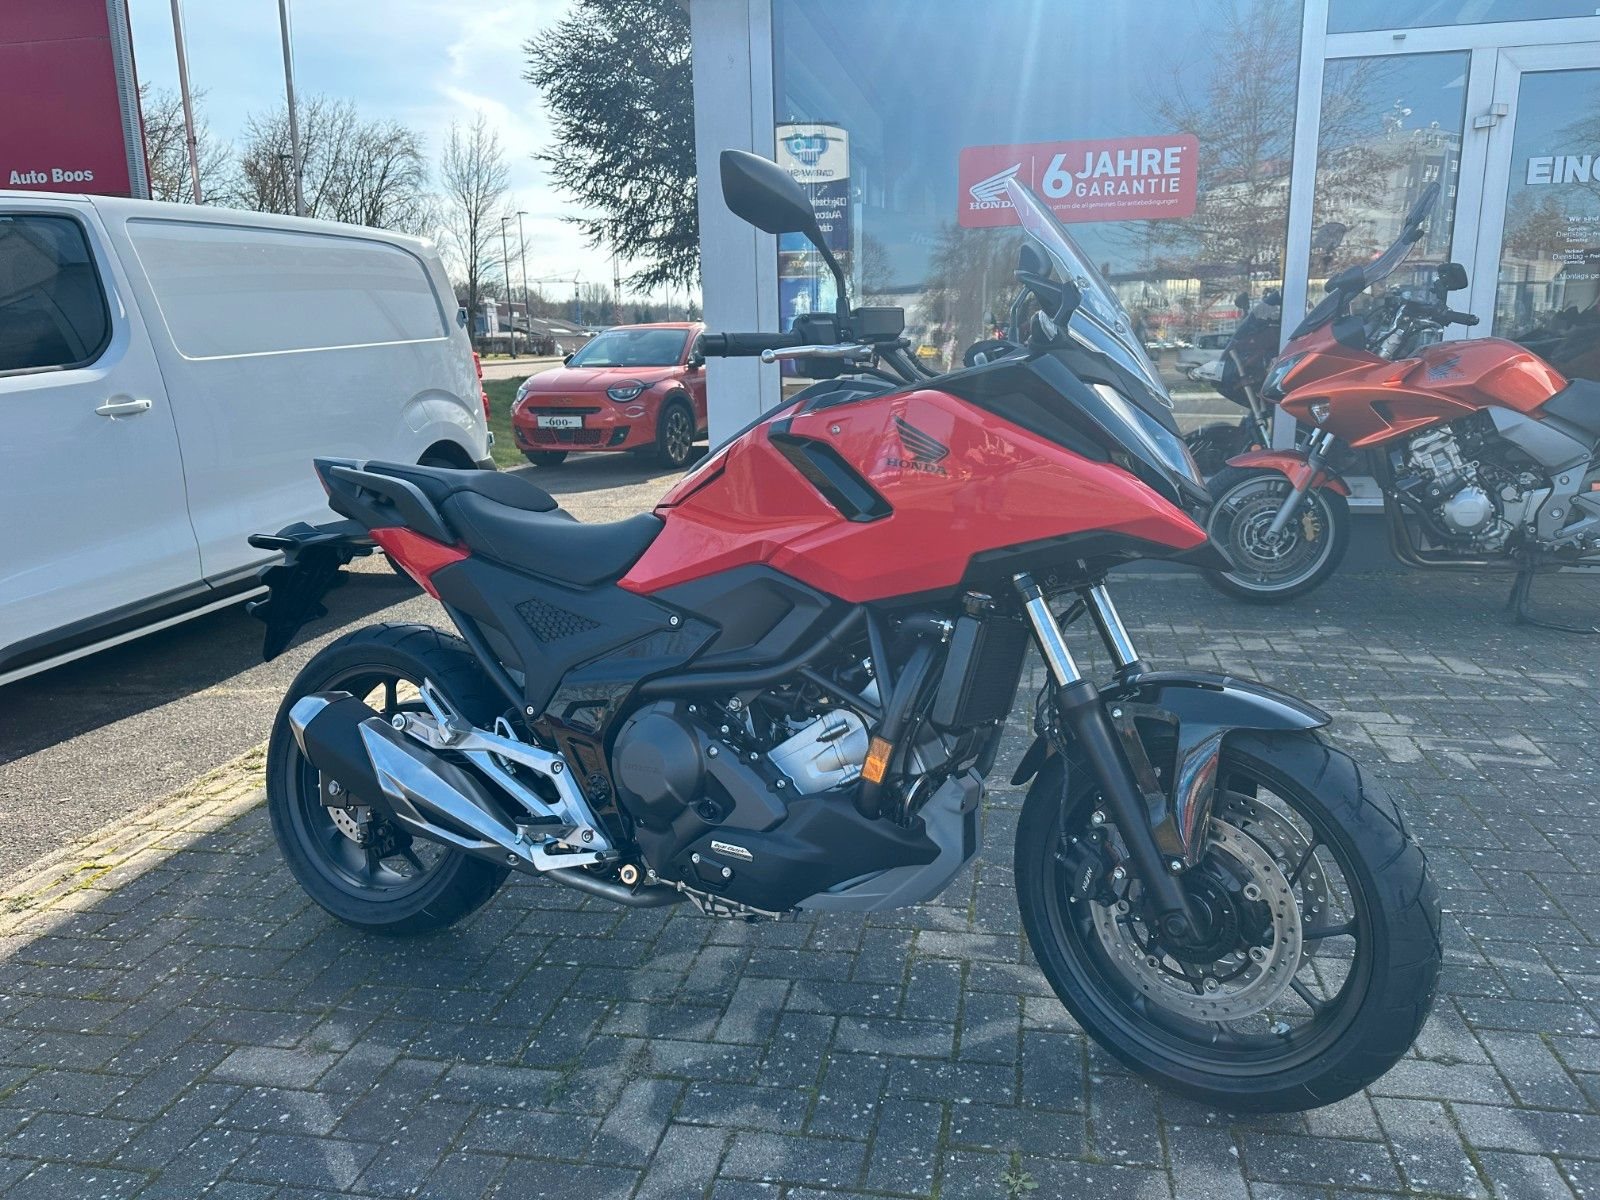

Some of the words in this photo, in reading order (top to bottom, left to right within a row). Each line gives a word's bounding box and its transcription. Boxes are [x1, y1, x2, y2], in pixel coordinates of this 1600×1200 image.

[9, 170, 48, 185] Auto
[52, 168, 94, 183] Boos
[1042, 153, 1073, 199] 6
[1075, 146, 1182, 179] JAHRE
[1075, 177, 1181, 197] GARANTIE
[1552, 253, 1584, 261] Dienstag
[887, 457, 947, 475] HONDA
